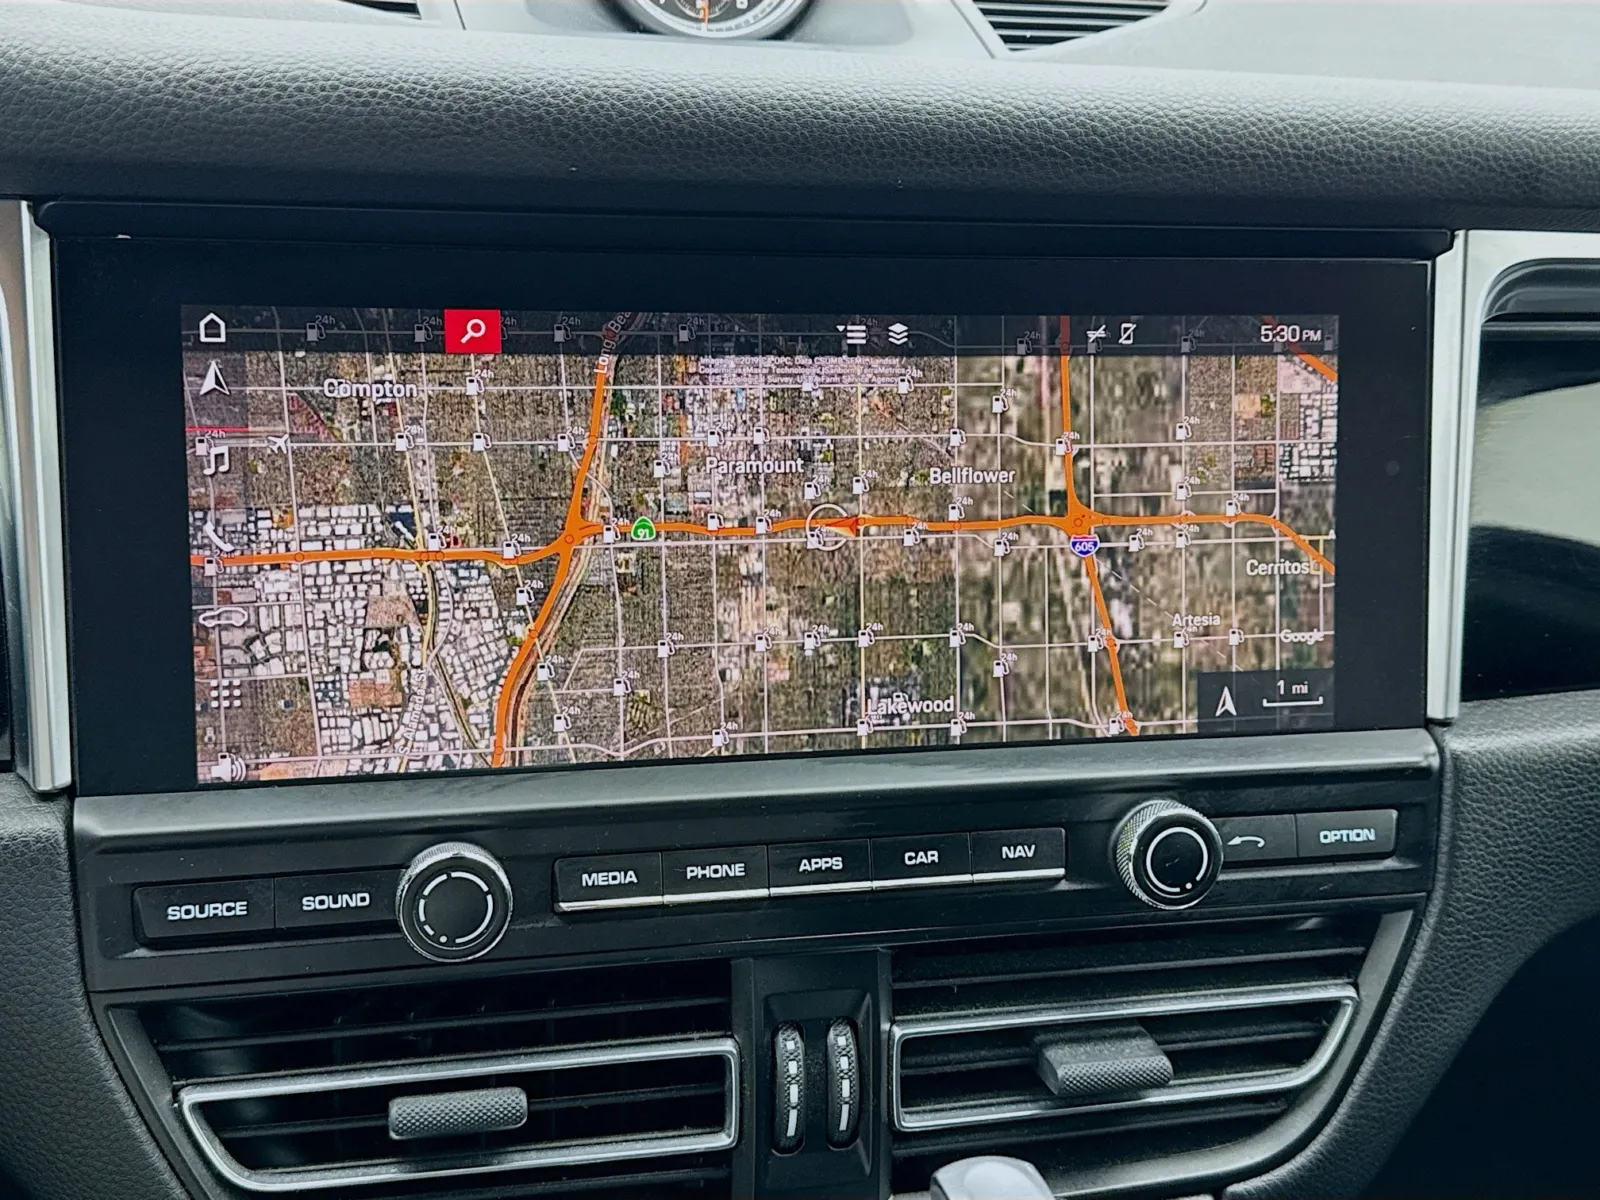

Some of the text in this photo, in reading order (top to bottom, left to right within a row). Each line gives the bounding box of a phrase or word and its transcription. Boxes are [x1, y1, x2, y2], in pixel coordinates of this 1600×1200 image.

[1260, 324, 1322, 342] 5:30 PM
[594, 339, 616, 374] Long
[323, 378, 418, 401] Compton
[705, 456, 804, 475] Paramount
[929, 466, 1016, 484] Bellflower
[637, 528, 650, 540] 91
[1074, 541, 1094, 552] 605
[1246, 558, 1310, 575] Cerritos
[1171, 612, 1221, 628] Artesia
[1280, 628, 1324, 645] Google
[1278, 681, 1308, 694] 1 mi
[402, 688, 426, 740] Alameda
[415, 668, 427, 682] St
[867, 695, 954, 714] Lakewood
[1318, 826, 1376, 845] OPTION
[904, 848, 939, 866] CAR
[1001, 842, 1036, 860] NAV
[686, 862, 746, 882] PHONE
[798, 854, 843, 873] APPS
[581, 869, 638, 888] MEDIA
[166, 900, 248, 922] SOURCE
[302, 892, 370, 912] SOUND
